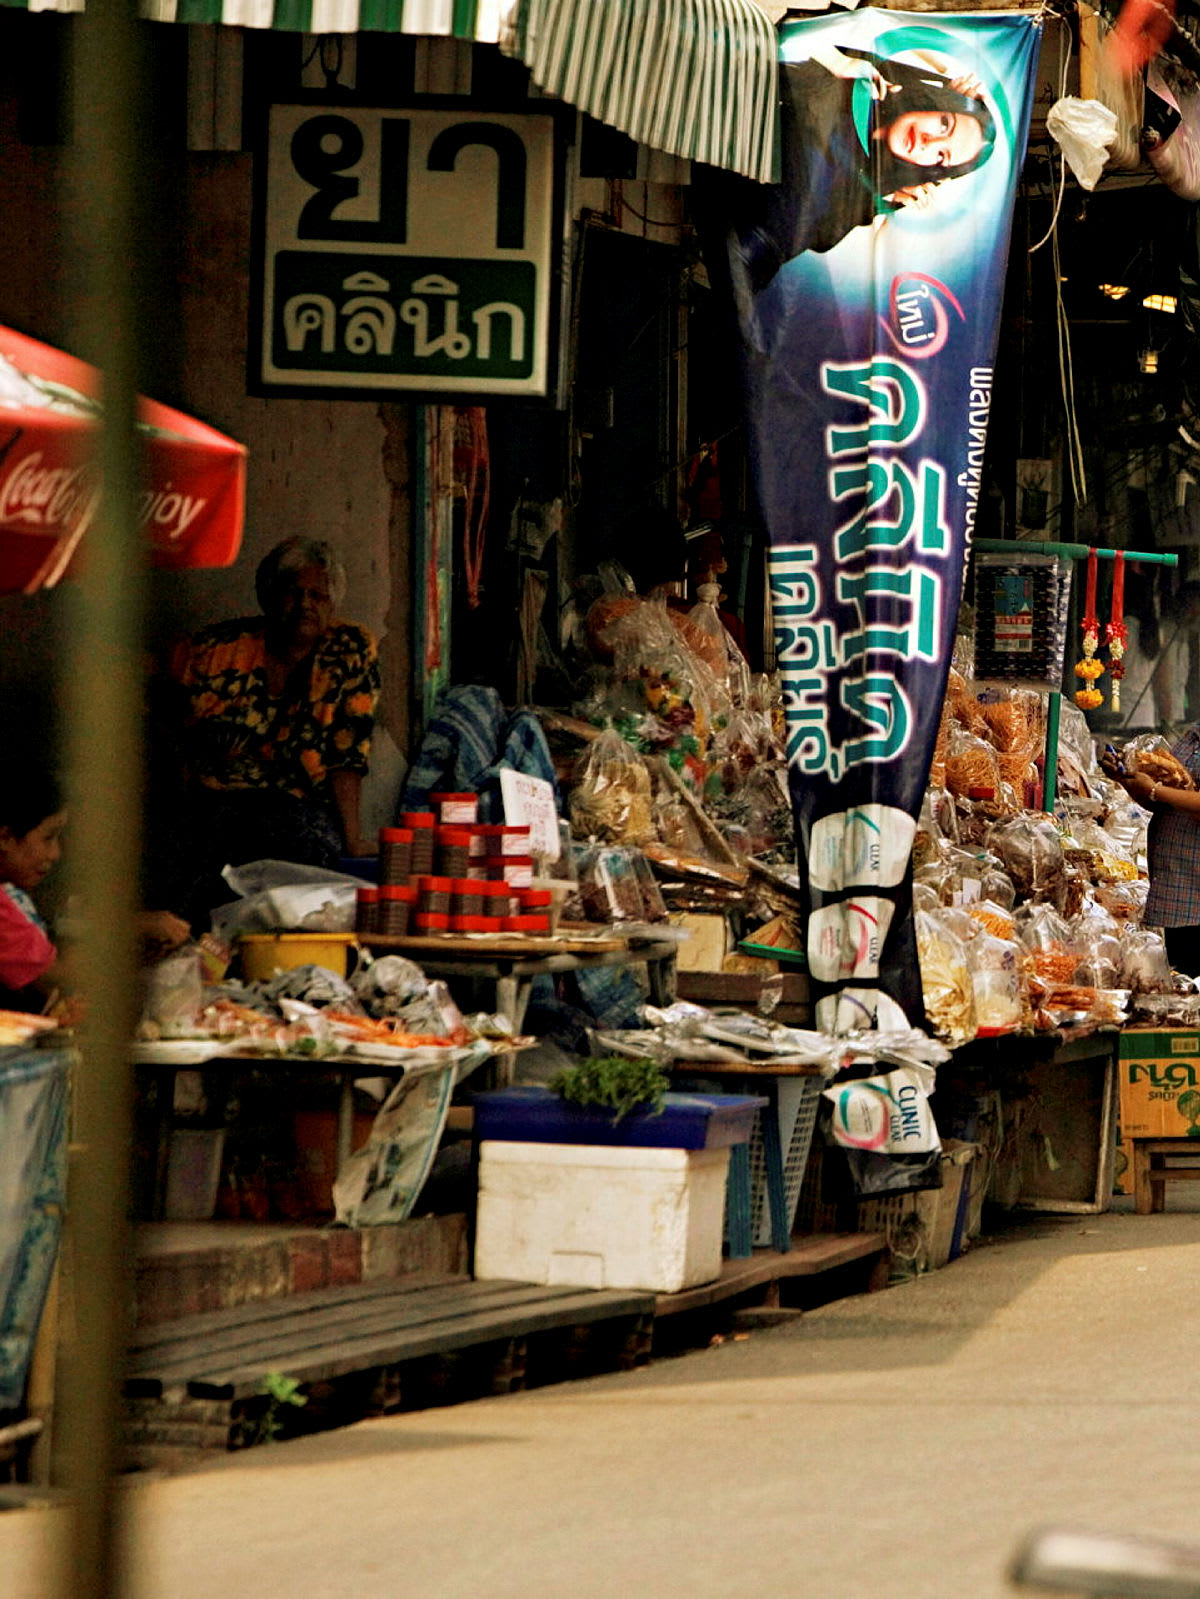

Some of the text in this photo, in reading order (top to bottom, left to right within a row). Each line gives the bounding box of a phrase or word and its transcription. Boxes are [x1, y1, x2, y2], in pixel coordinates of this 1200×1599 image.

[290, 113, 529, 249] ยา
[283, 271, 527, 361] คลินิก
[894, 284, 936, 344] ใหม่
[889, 1114, 902, 1143] CLEAR
[898, 1085, 921, 1142] CLINIC
